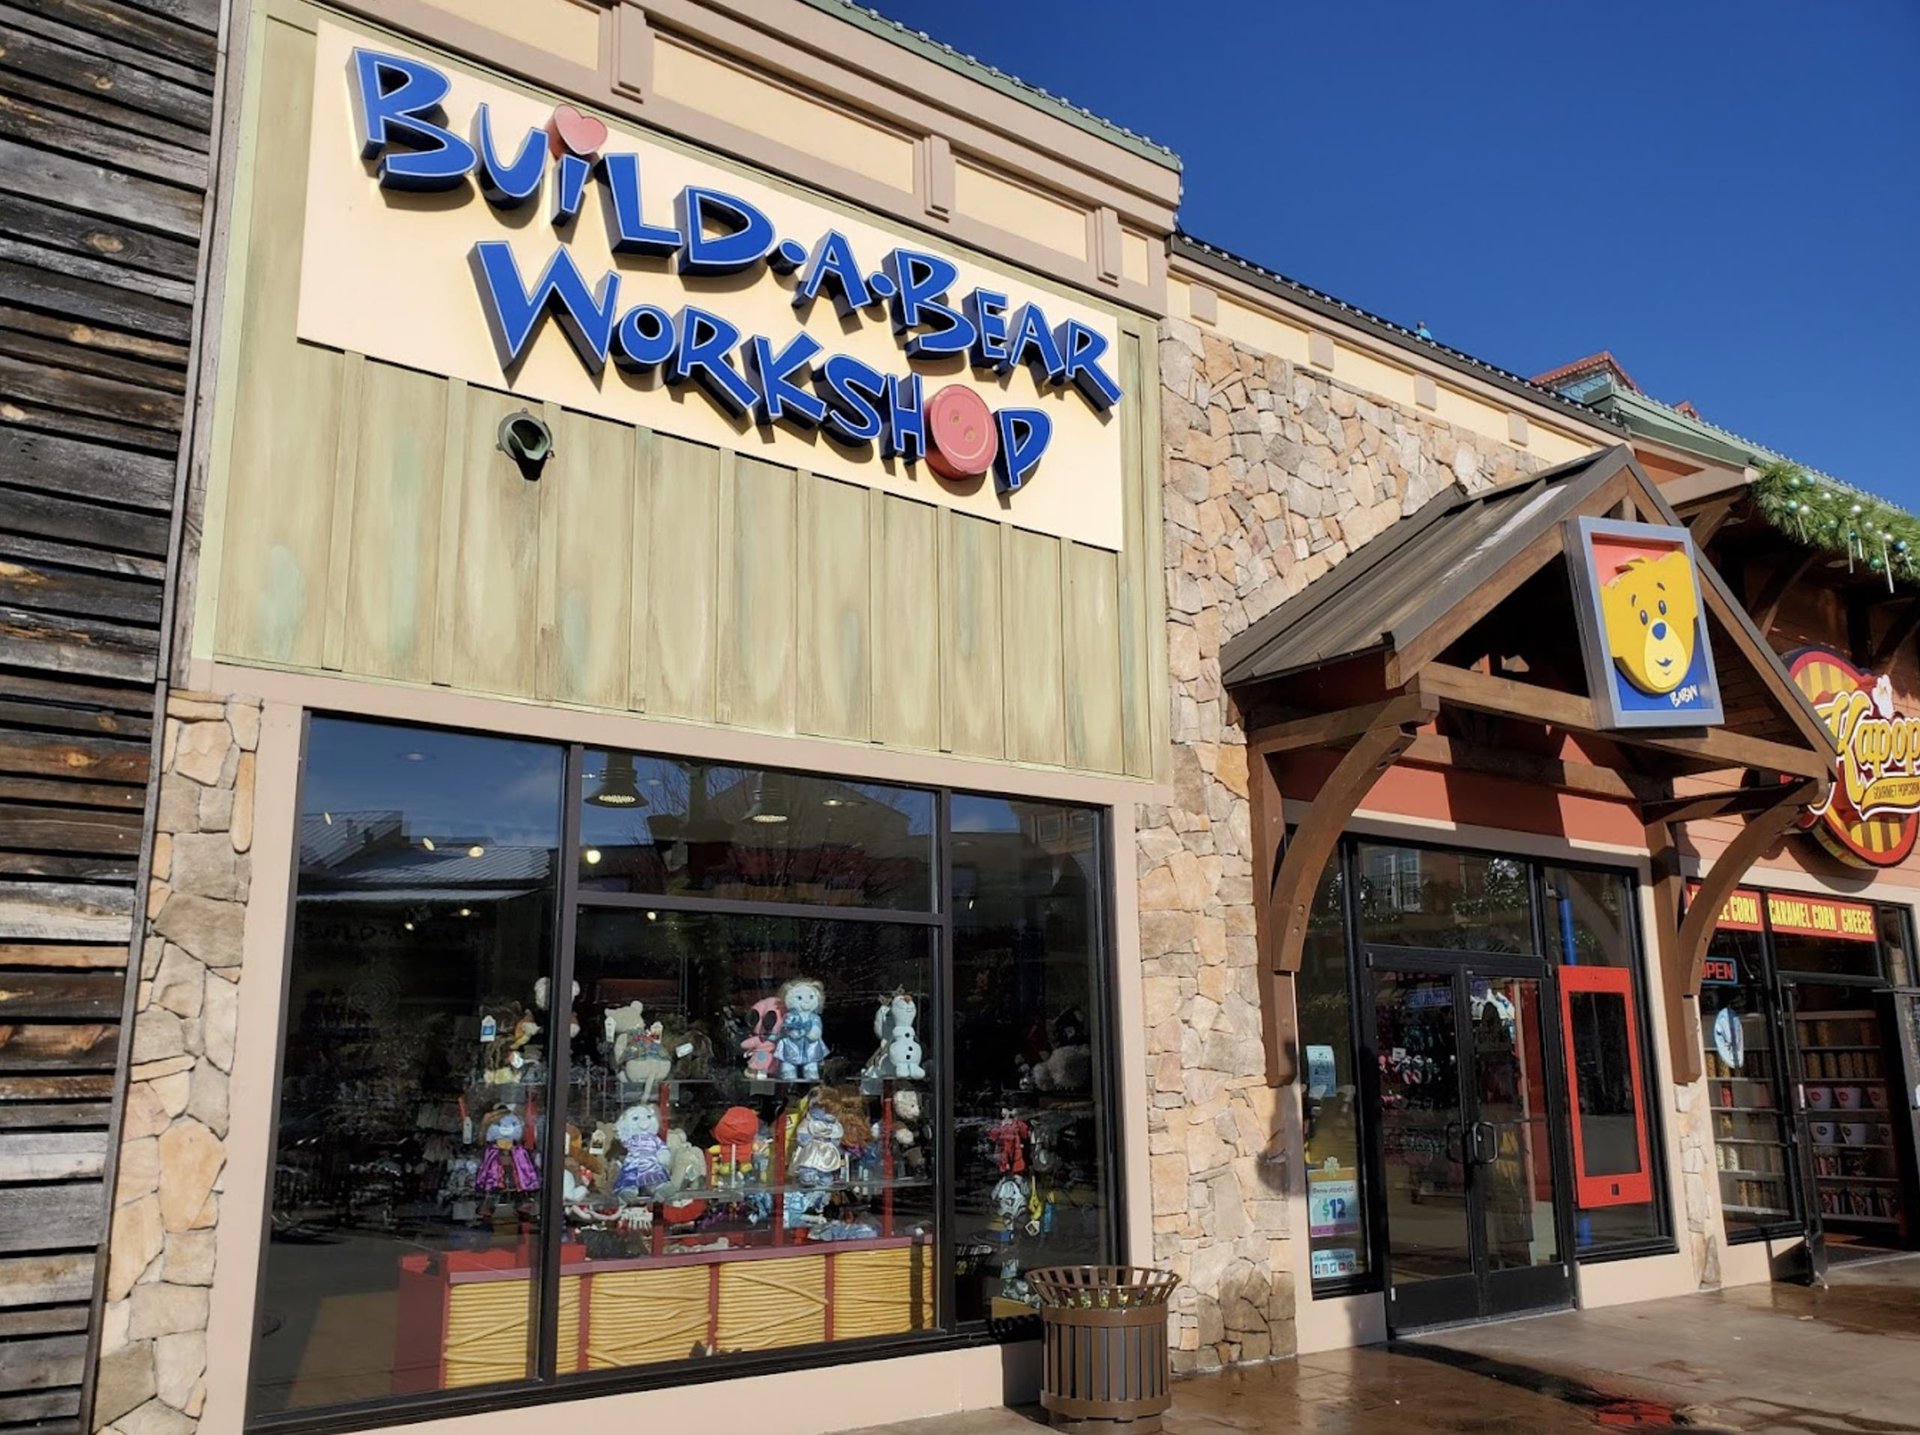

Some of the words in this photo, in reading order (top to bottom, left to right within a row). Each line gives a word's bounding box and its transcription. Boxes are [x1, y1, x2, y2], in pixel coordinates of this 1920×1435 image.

[469, 240, 1053, 497] WORKSHOP
[1729, 895, 1758, 924] CORN
[1768, 899, 1812, 928] CARAMEL
[1812, 904, 1837, 931] CORN
[1840, 908, 1874, 934] CHEESE
[1322, 1197, 1346, 1222] $12
